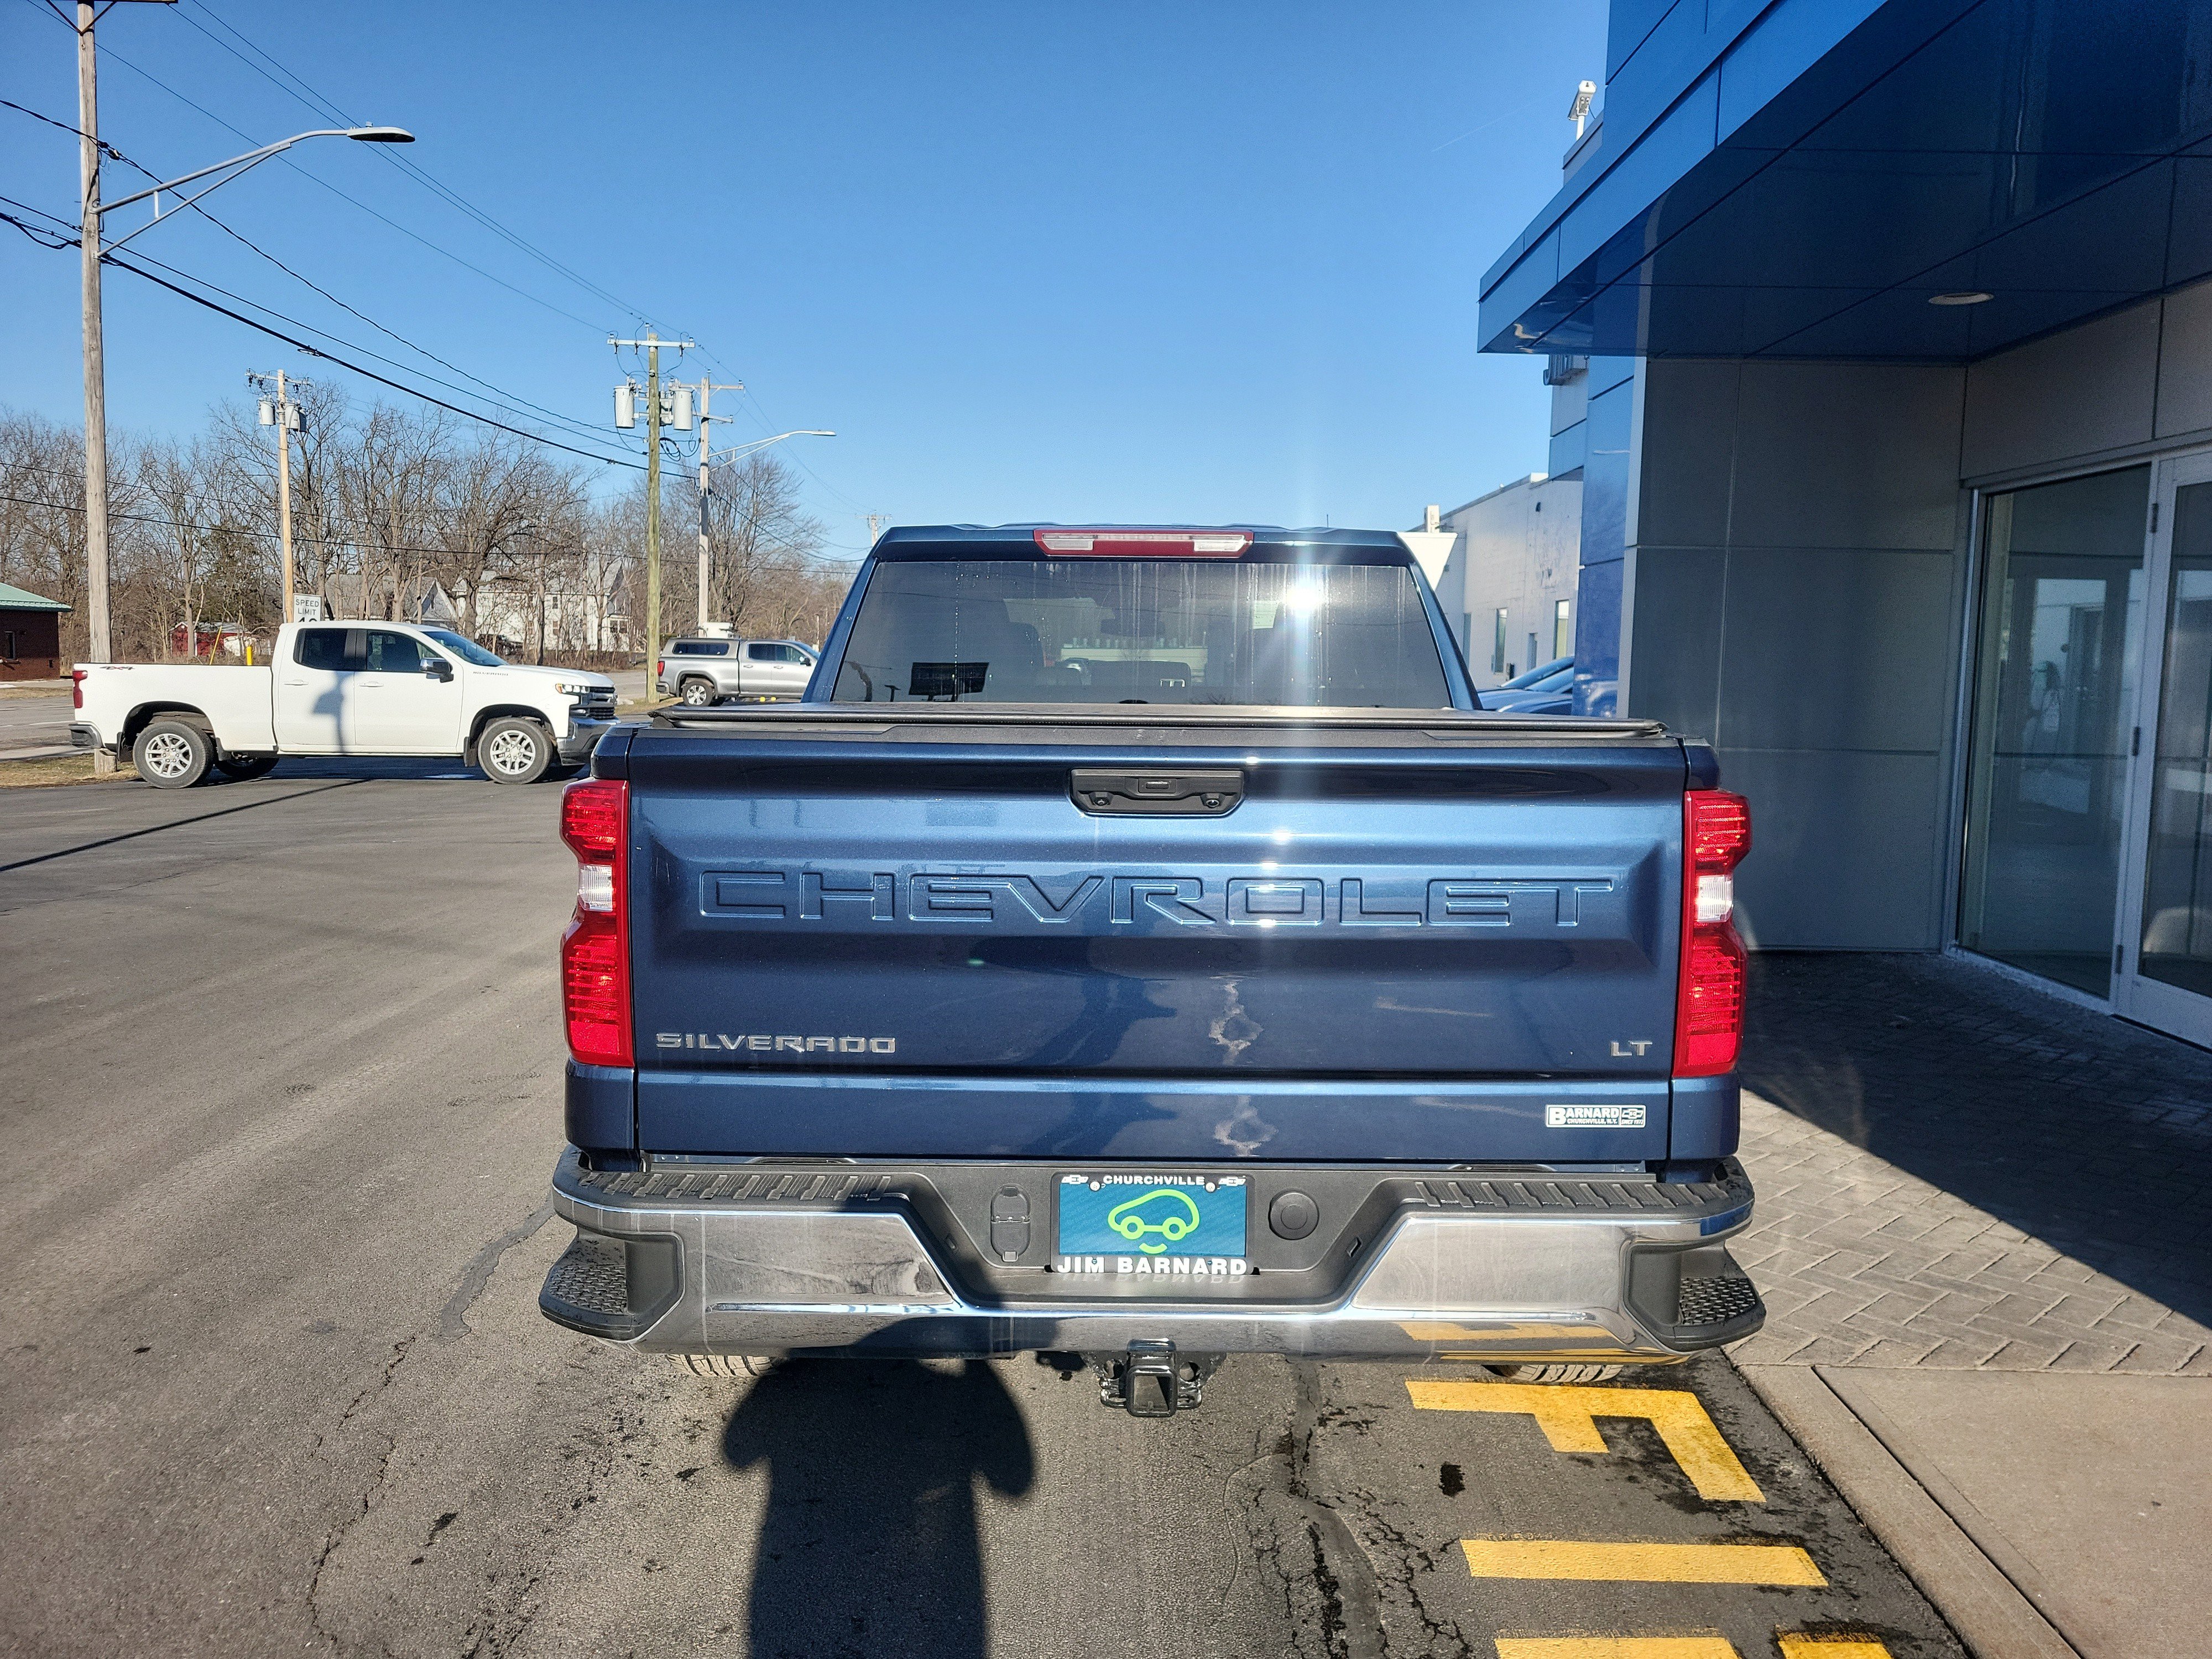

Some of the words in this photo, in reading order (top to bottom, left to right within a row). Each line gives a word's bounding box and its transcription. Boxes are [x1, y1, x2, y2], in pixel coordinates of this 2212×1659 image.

[295, 599, 319, 607] SPEED
[700, 870, 1614, 926] CHEVROLET
[656, 1032, 896, 1054] SILVERADO
[1610, 1040, 1653, 1056] LT
[1549, 1107, 1619, 1125] BARNARD
[1103, 1175, 1205, 1186] CHURCHVILLE
[1057, 1256, 1105, 1274] JIM
[1117, 1257, 1247, 1275] BARNARD
